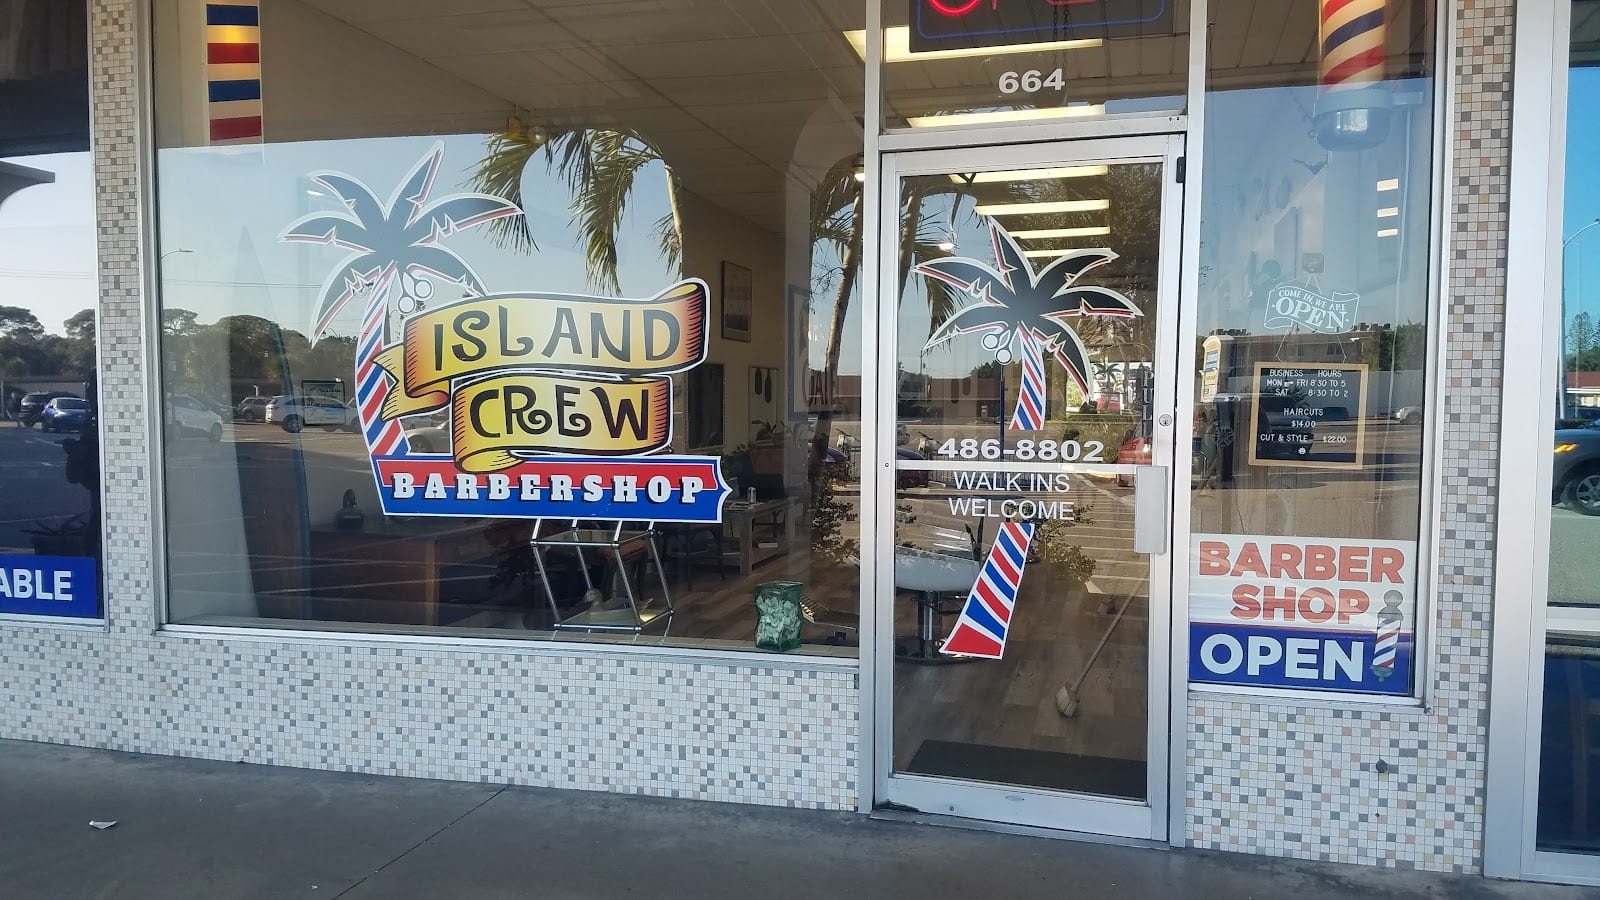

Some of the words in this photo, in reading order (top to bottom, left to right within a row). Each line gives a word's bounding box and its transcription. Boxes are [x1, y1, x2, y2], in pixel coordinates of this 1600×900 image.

[998, 68, 1066, 94] 664
[1279, 289, 1302, 298] COME
[1315, 299, 1328, 309] WE
[1329, 303, 1348, 312] ARE
[1275, 297, 1347, 329] OPEN
[433, 305, 681, 372] ISLAND
[1266, 379, 1283, 387] MON
[1296, 379, 1309, 387] FRI
[1269, 369, 1304, 378] BUSINESS
[1317, 370, 1342, 378] HOURS
[1275, 388, 1289, 396] SAT
[1308, 389, 1327, 397] 8:30
[1343, 390, 1349, 398] 2
[469, 384, 649, 441] CREW
[1283, 407, 1324, 416] HAIRCUTS
[1291, 420, 1316, 428] $14.00
[938, 438, 1104, 462] 486-8802
[1260, 433, 1276, 442] CUT
[1277, 433, 1284, 442] &
[1286, 433, 1308, 442] STYLE
[1322, 435, 1347, 443] $22.00
[392, 472, 705, 504] BARBERSHOP
[953, 471, 1022, 491] WALK
[1030, 473, 1070, 493] INS
[948, 497, 1075, 521] WELCOME
[1199, 541, 1405, 584] BARBER
[1230, 583, 1370, 624] SHOP
[1200, 633, 1364, 682] OPEN
